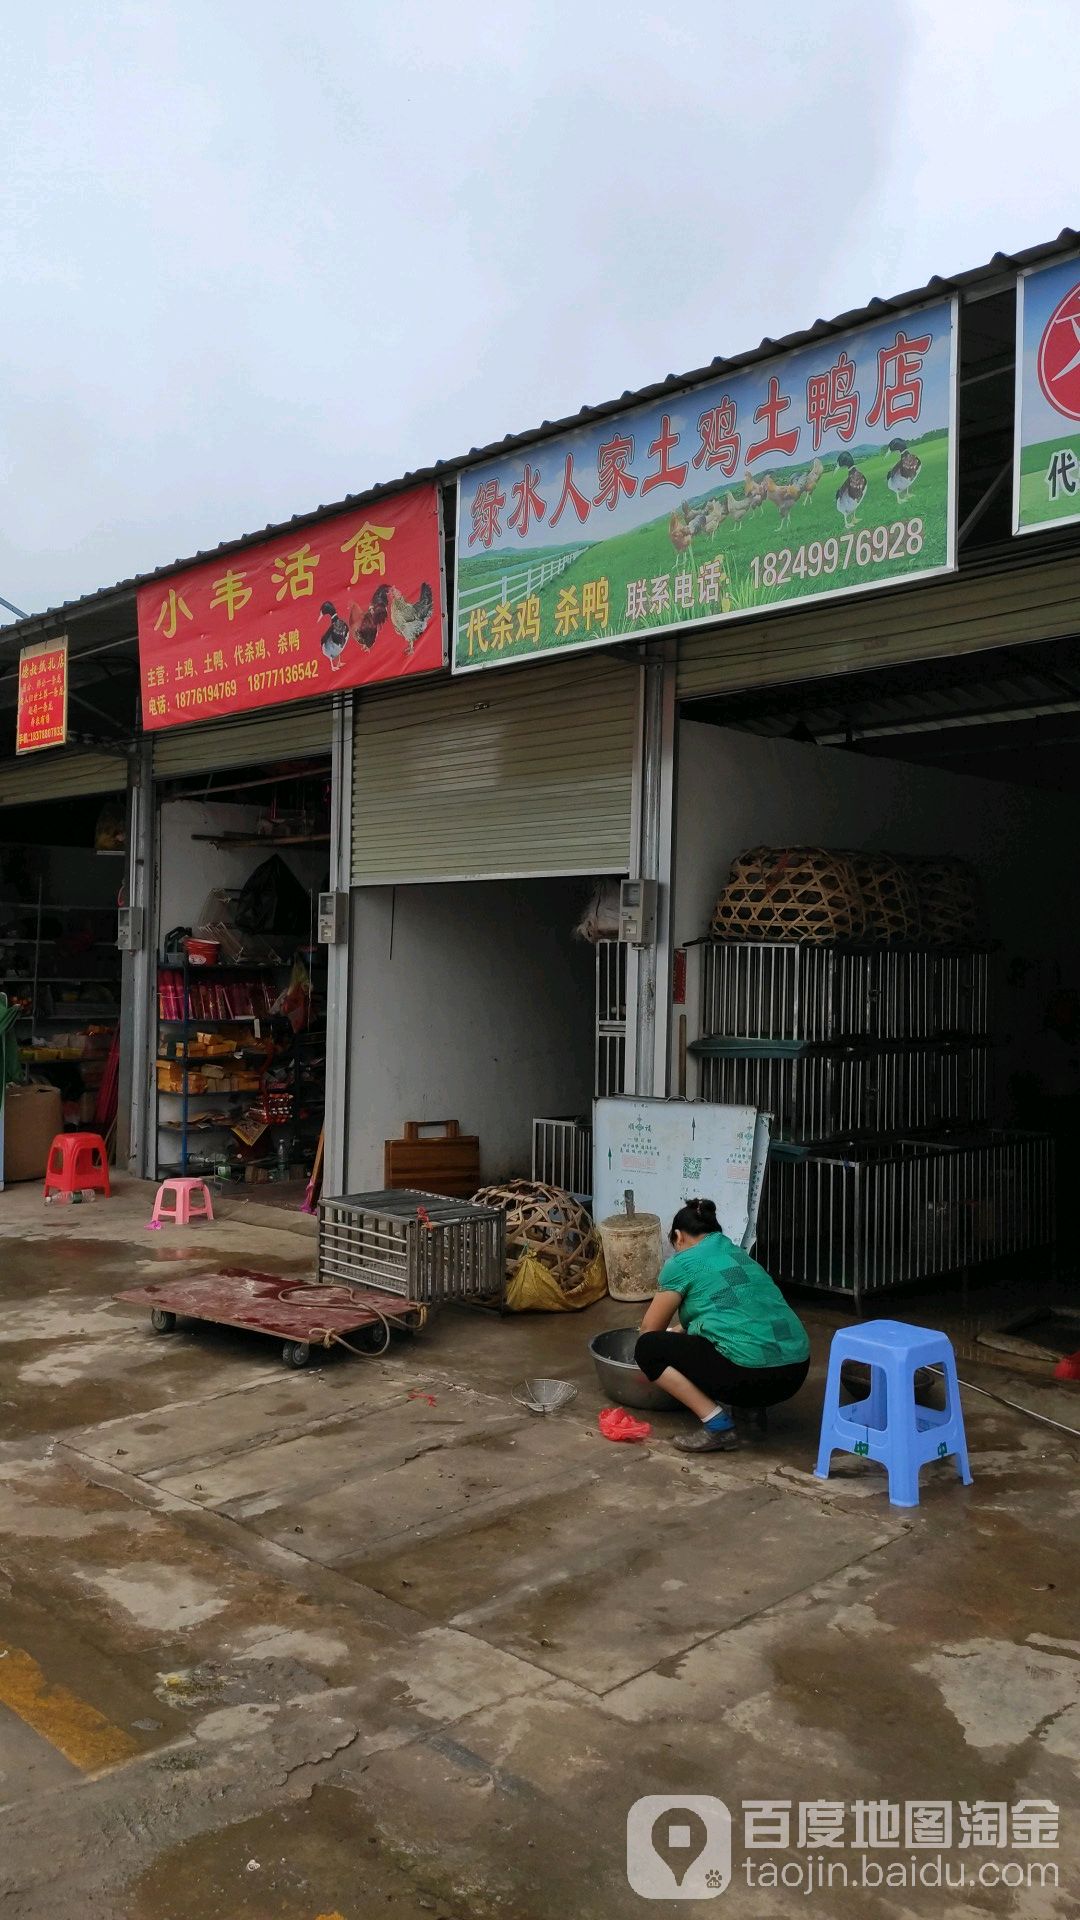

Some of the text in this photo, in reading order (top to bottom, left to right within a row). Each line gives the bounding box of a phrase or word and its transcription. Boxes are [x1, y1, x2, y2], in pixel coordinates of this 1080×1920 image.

[467, 330, 933, 549] 绿水人家土鸡土鸭店
[154, 520, 396, 638] 小韦活禽
[466, 594, 541, 656] 代杀鸡
[554, 576, 609, 637] 杀鸭
[750, 517, 923, 589] 18249976928
[247, 659, 319, 693] 18777136542
